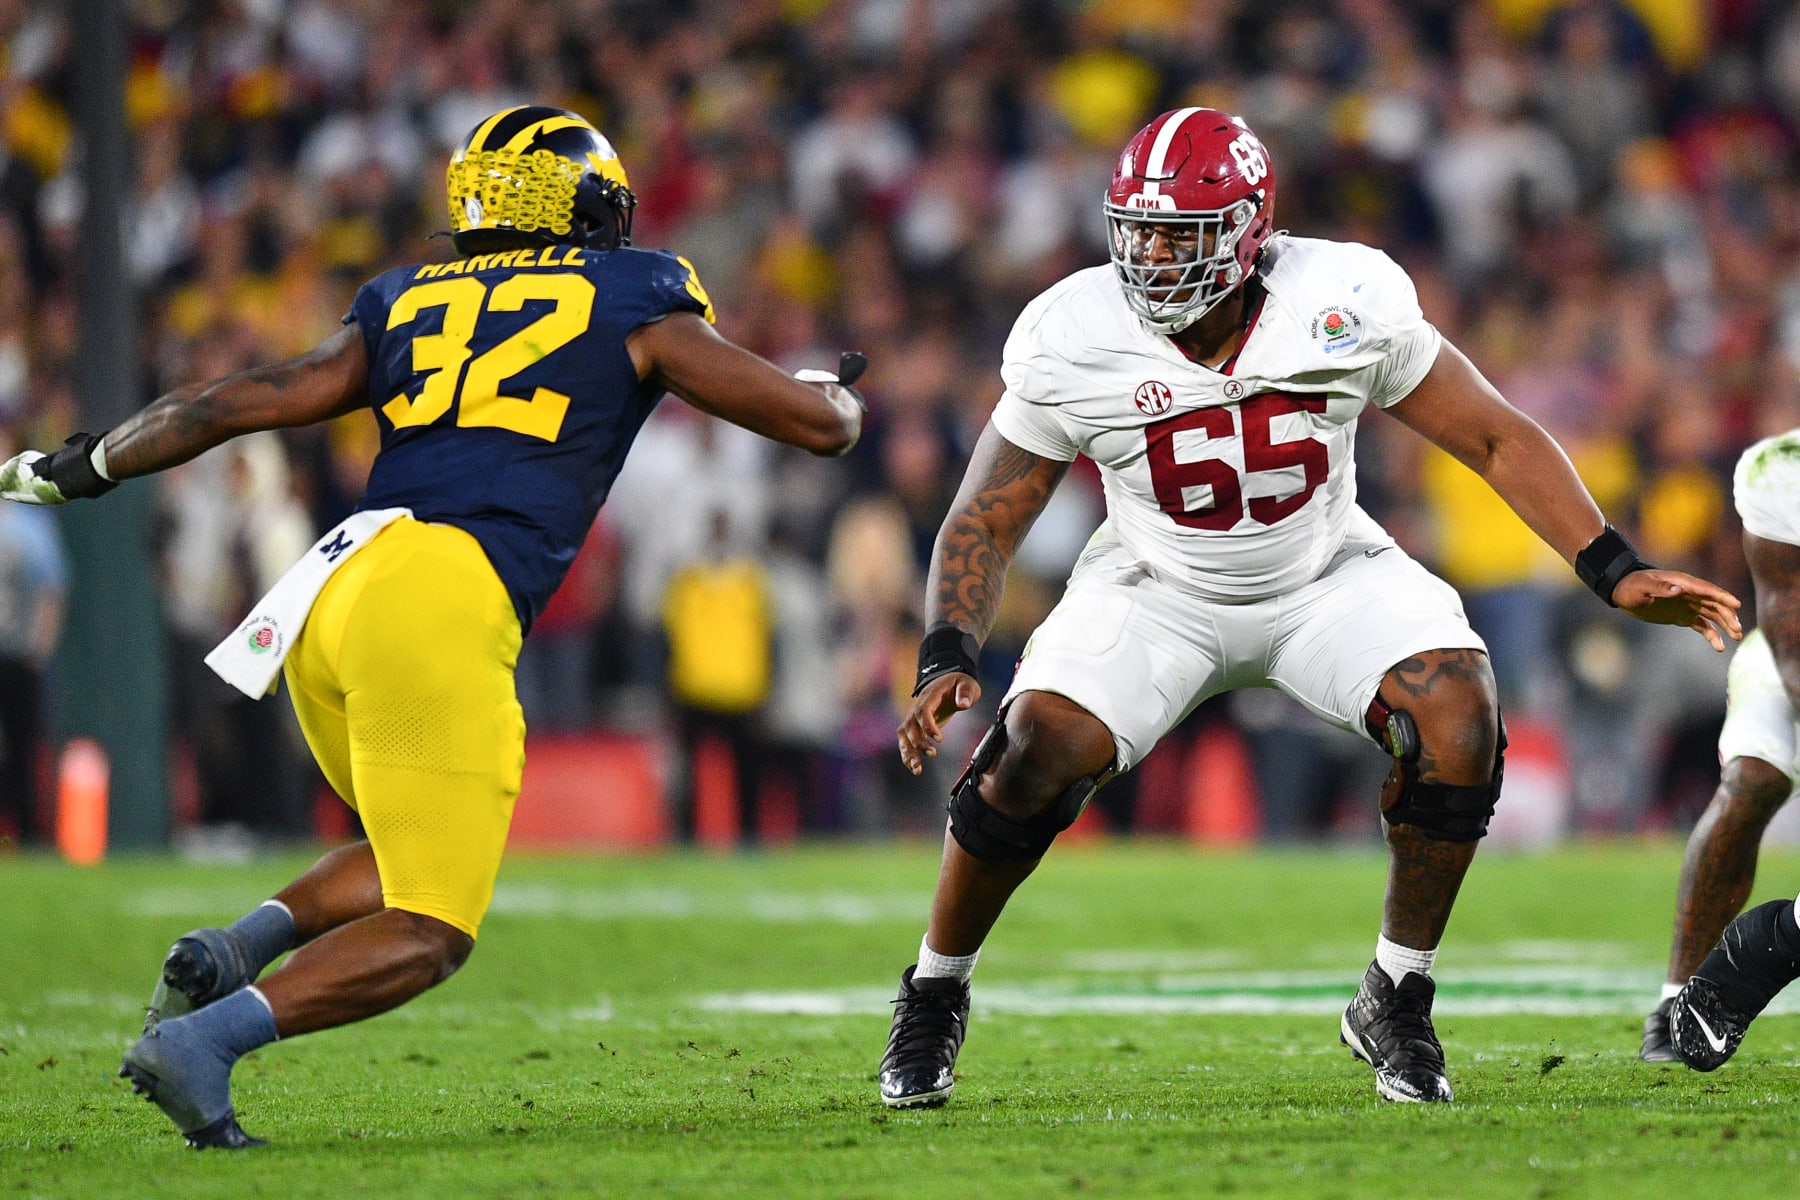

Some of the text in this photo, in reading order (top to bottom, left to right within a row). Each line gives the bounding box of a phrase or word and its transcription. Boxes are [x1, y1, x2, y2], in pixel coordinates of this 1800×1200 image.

[1229, 132, 1267, 186] 65
[1343, 308, 1360, 327] GAME
[381, 273, 596, 442] 32
[1136, 383, 1171, 414] SEC
[1145, 392, 1329, 531] 65
[319, 530, 353, 563] M
